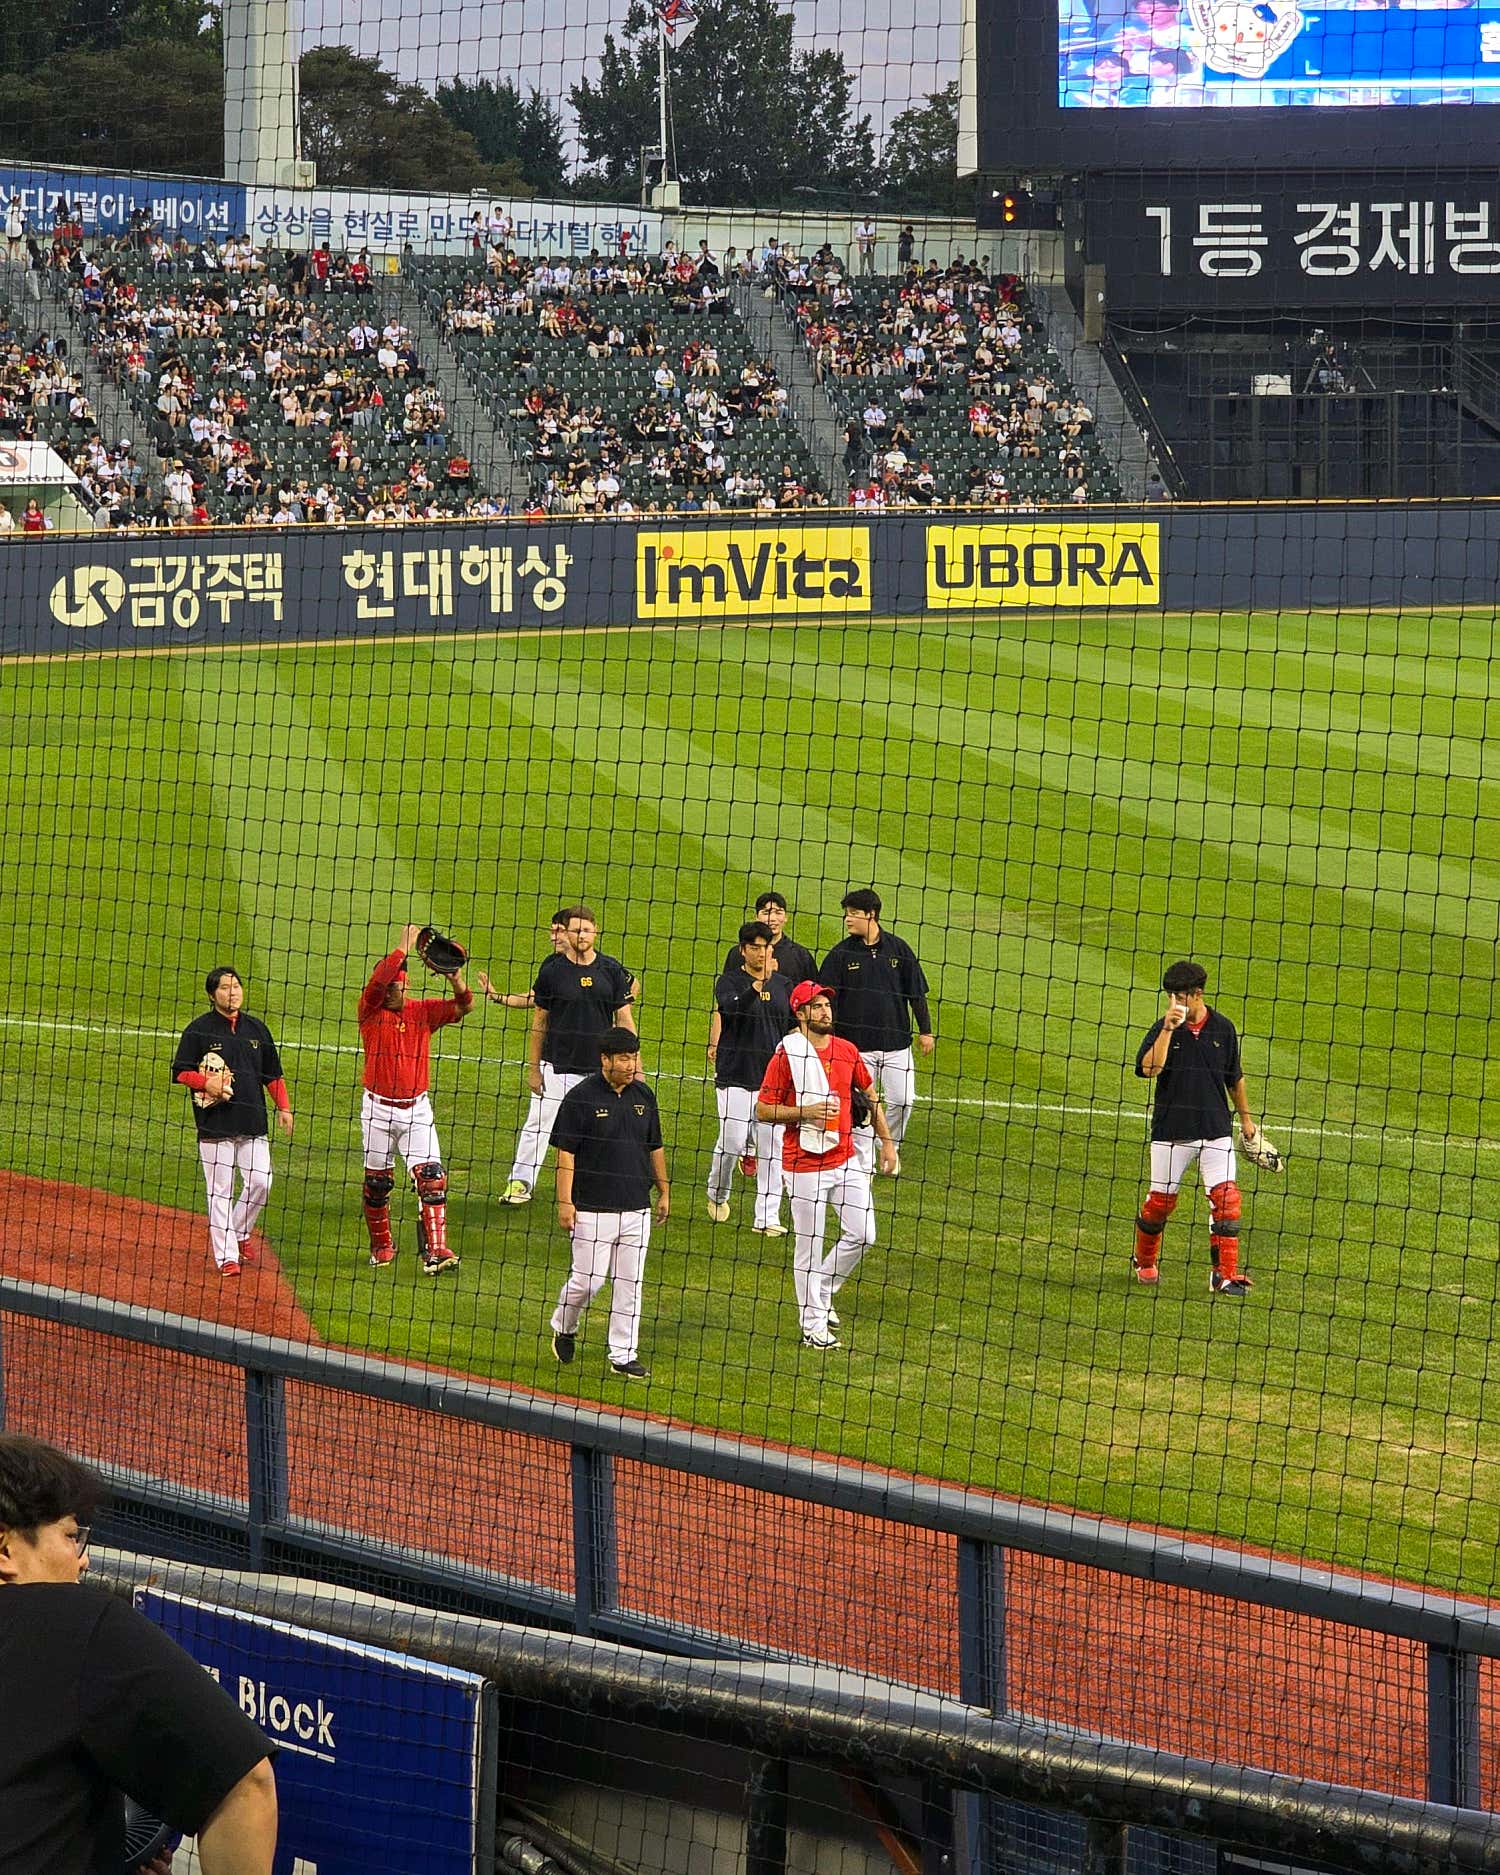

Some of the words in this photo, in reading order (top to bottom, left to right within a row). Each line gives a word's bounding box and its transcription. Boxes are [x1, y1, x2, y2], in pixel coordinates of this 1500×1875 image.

[257, 204, 334, 237] 상상을
[517, 218, 591, 250] 디지털
[1146, 203, 1268, 277] 1등
[129, 552, 284, 629] 금강주택
[342, 544, 574, 619] 현대해상
[934, 542, 1154, 589] UBORA
[238, 1675, 336, 1748] Block
